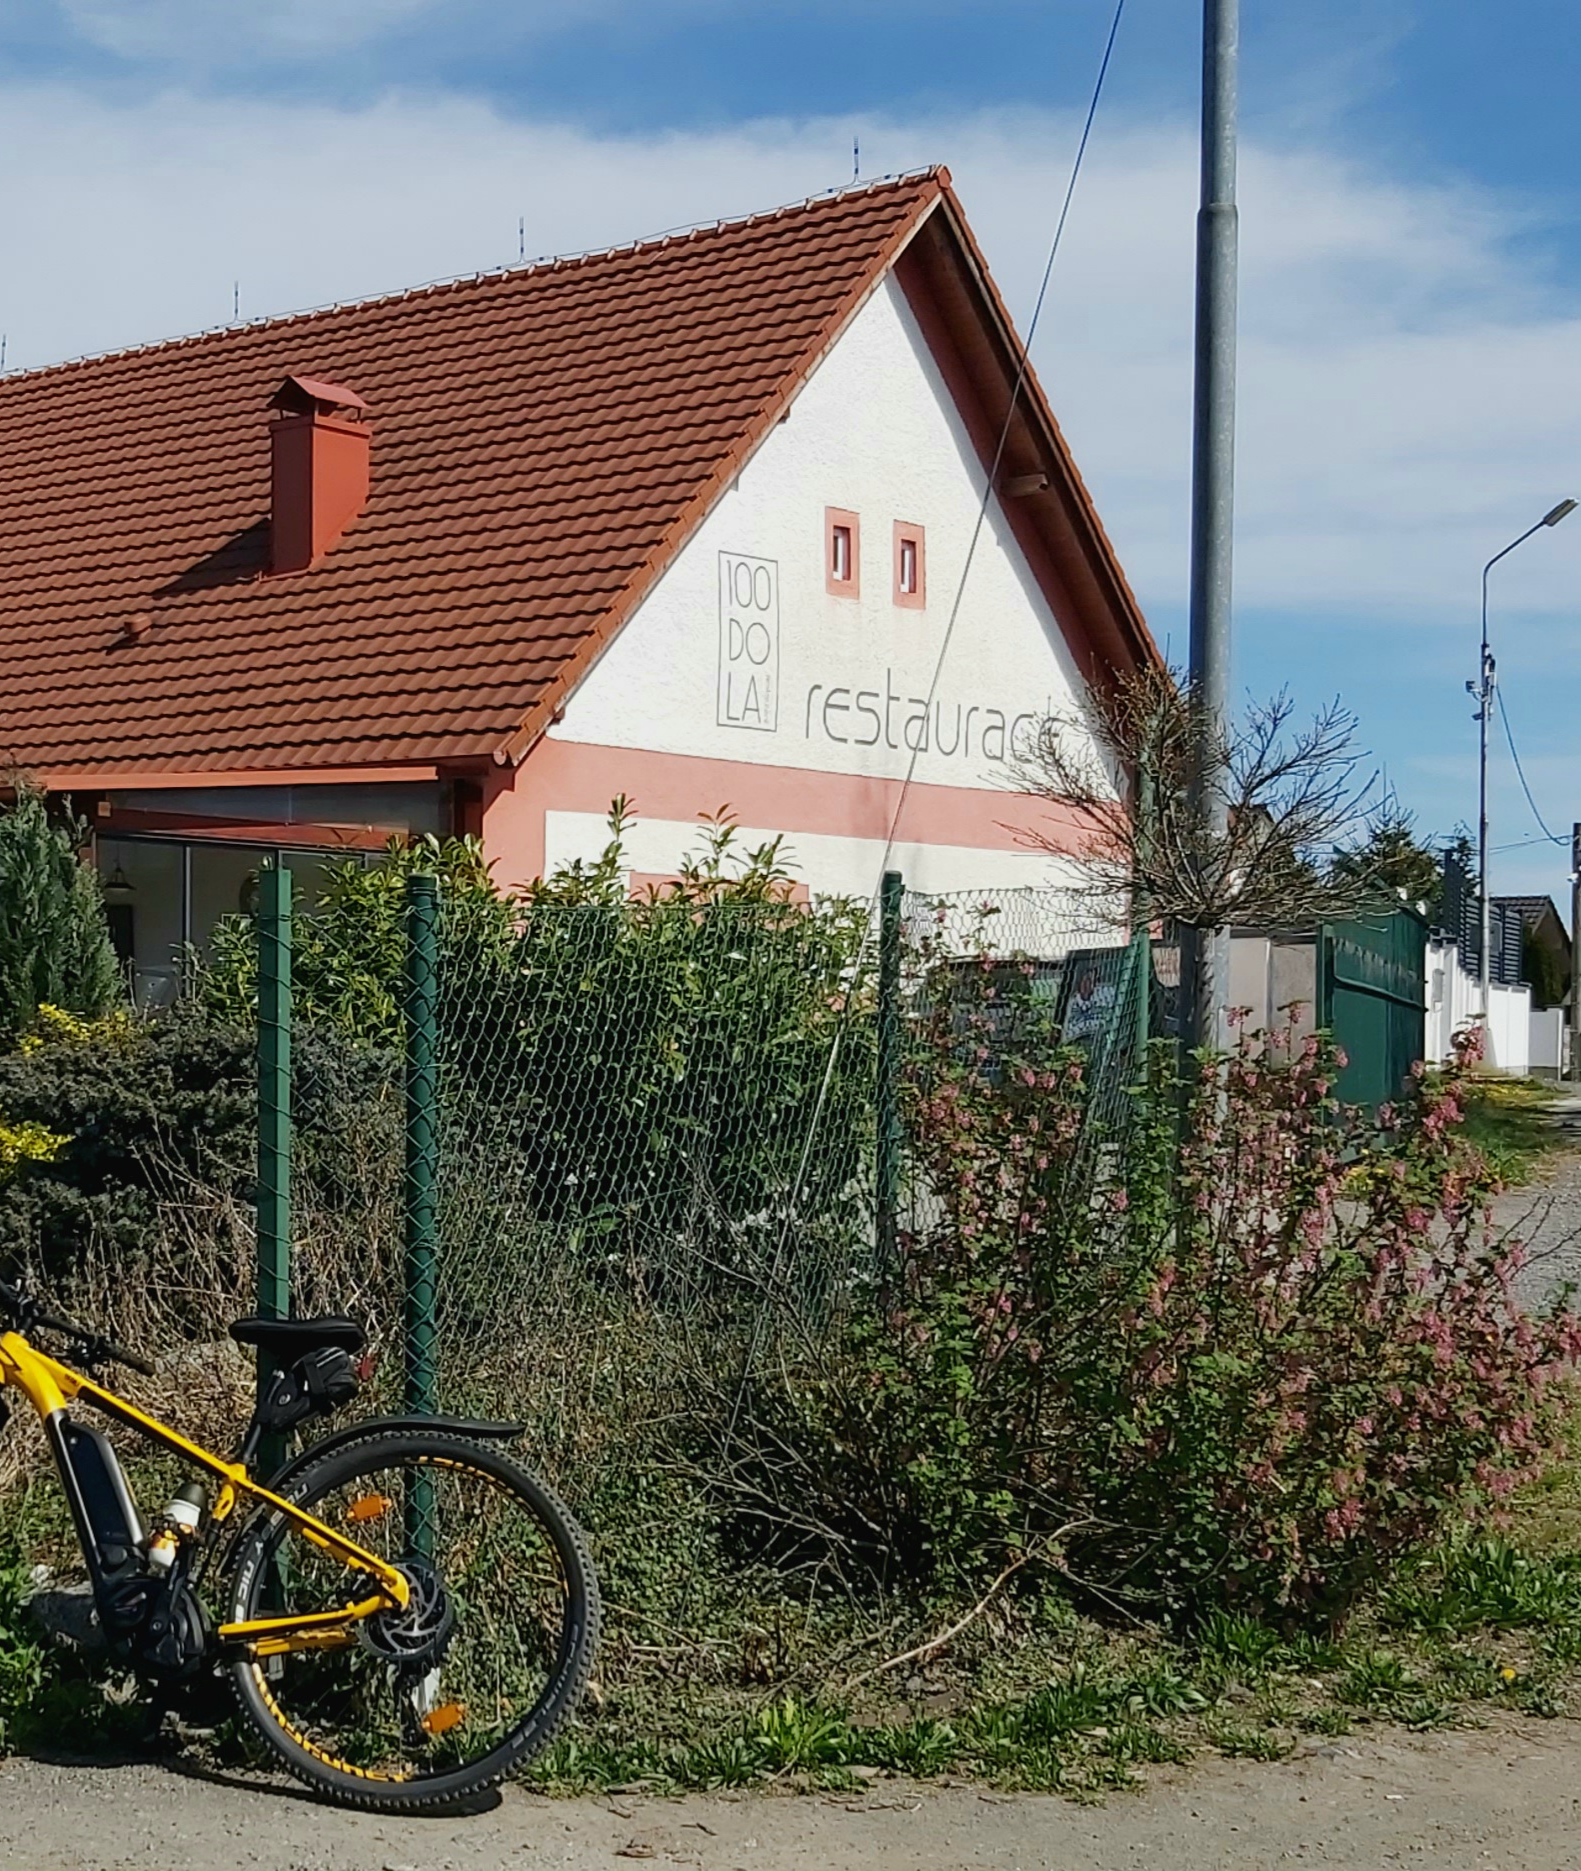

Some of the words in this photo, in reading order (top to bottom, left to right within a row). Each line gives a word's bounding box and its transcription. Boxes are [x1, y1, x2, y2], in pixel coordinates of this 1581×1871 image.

[725, 558, 772, 612] 100
[728, 617, 772, 666] DO
[725, 671, 762, 724] LA
